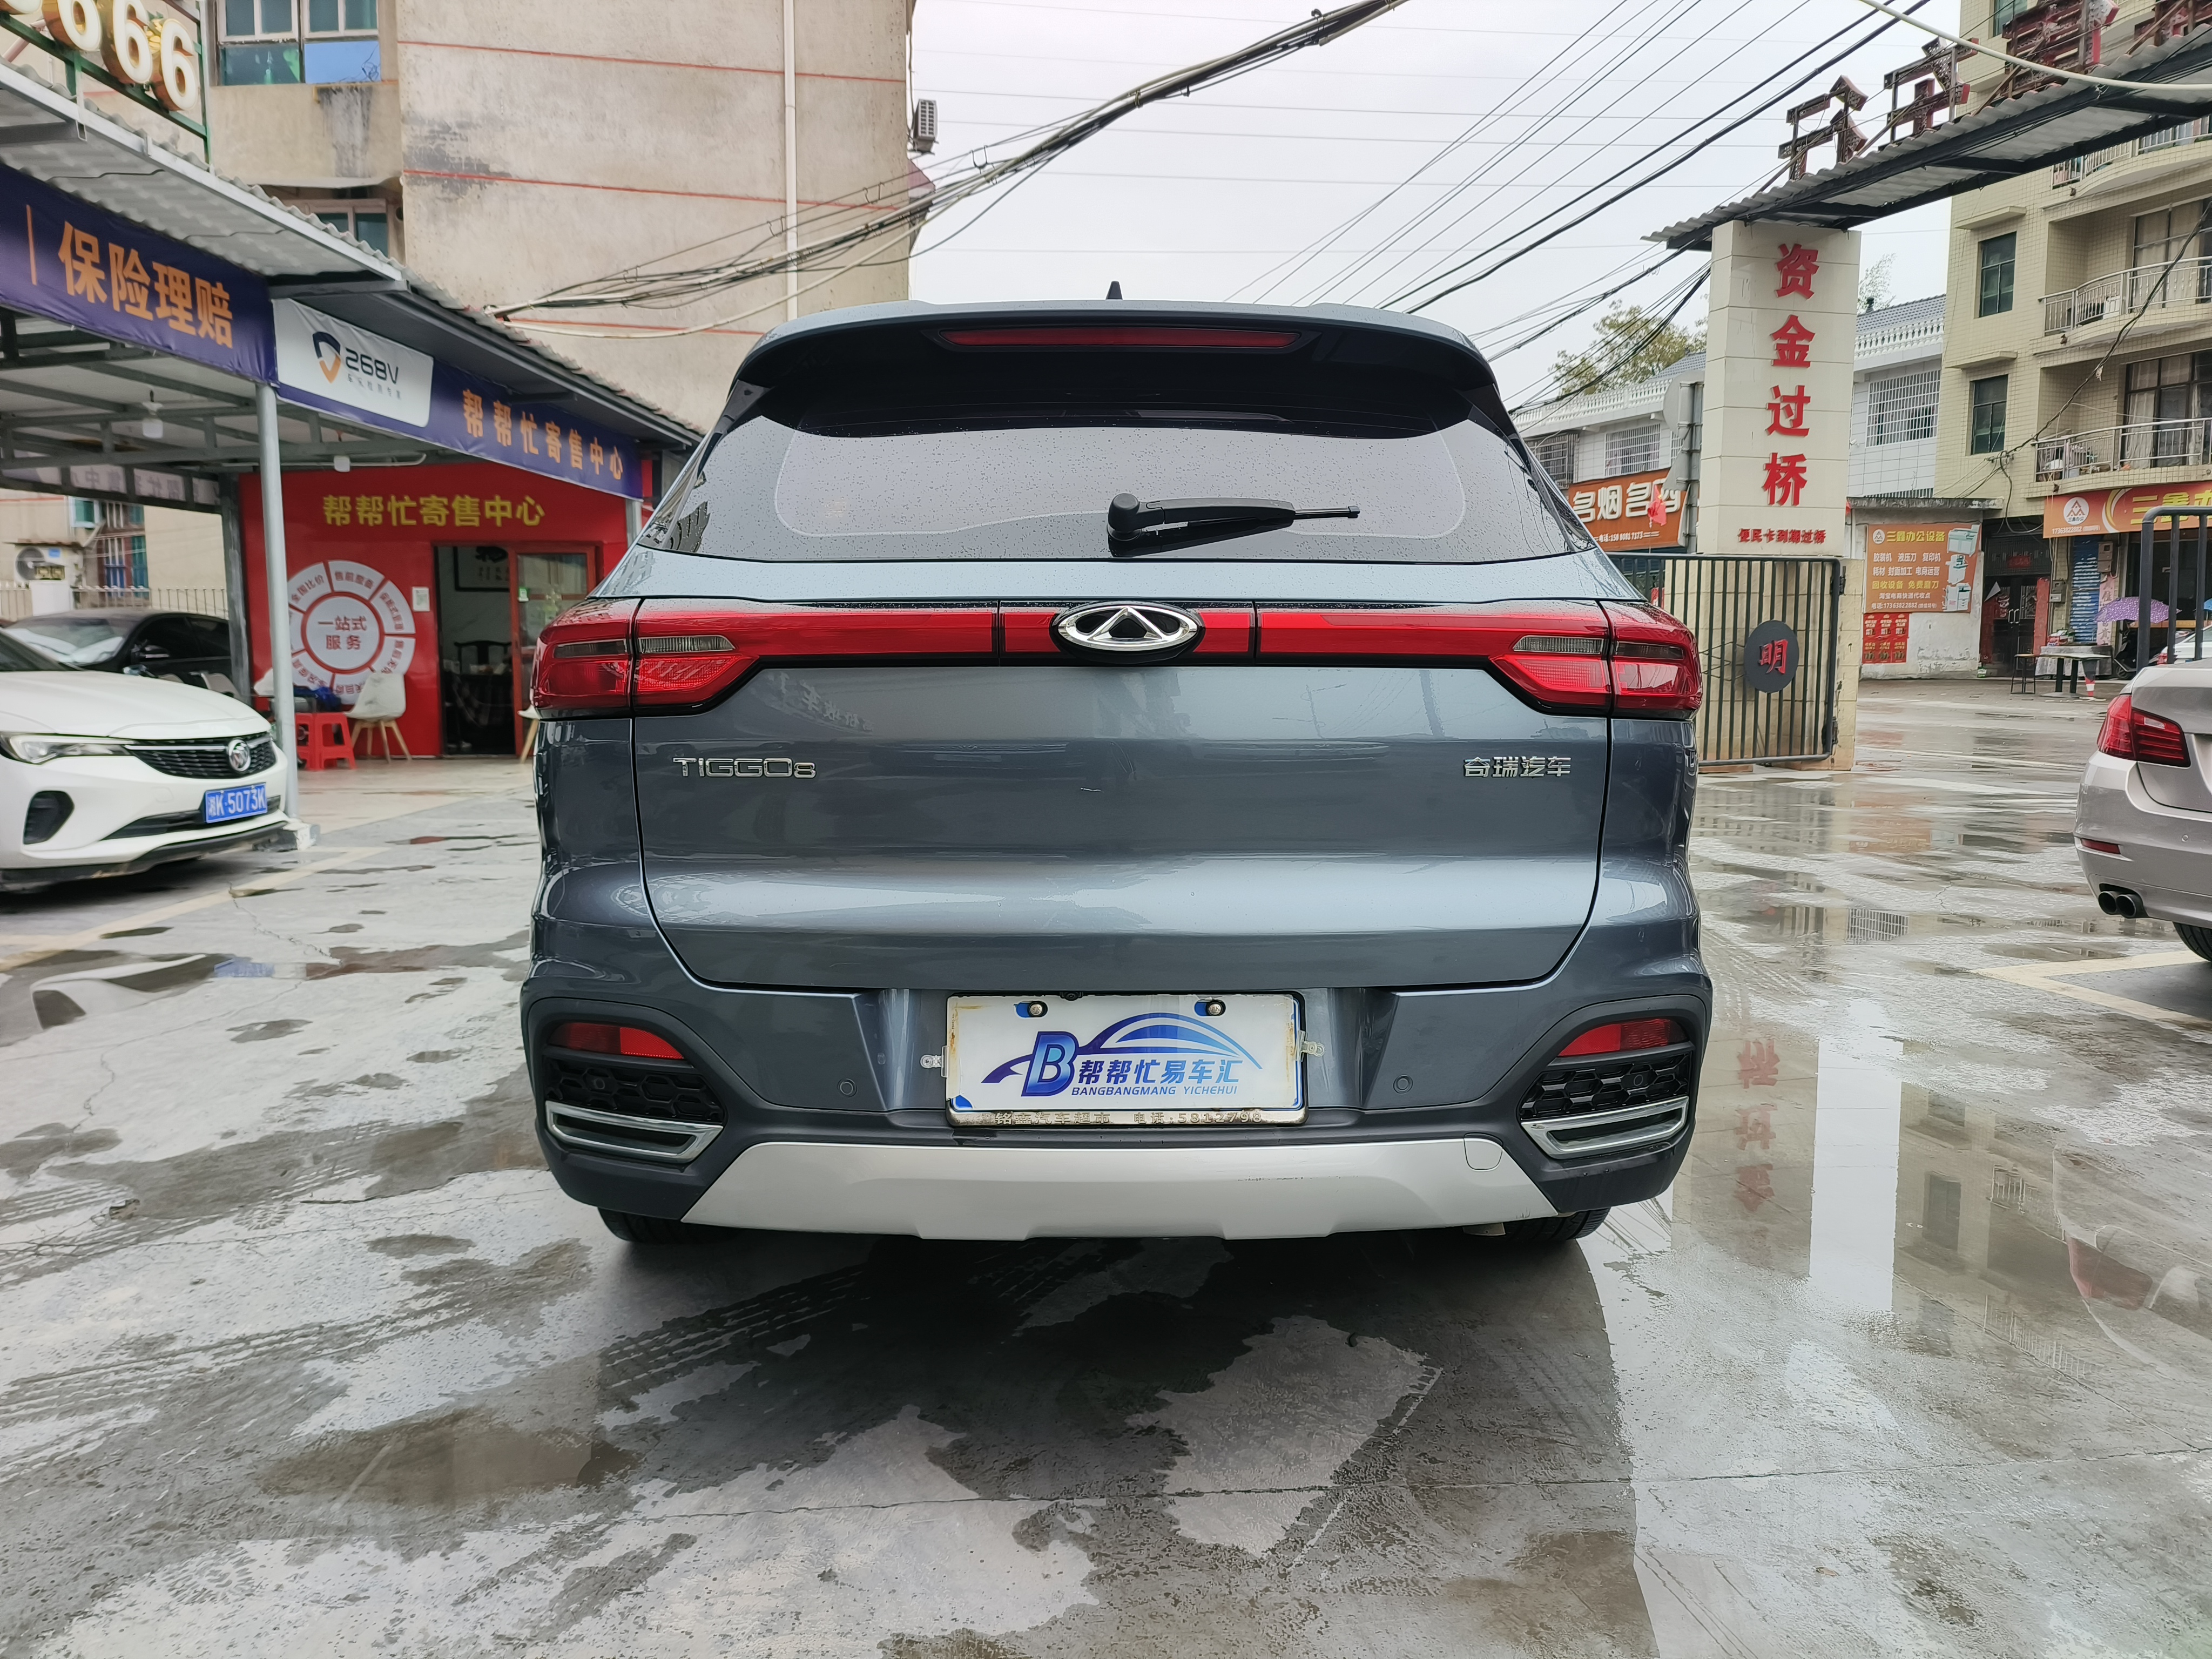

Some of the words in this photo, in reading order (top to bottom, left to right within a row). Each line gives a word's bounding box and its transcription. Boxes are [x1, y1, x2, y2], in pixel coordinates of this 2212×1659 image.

[58, 221, 233, 348] 保险理赔
[345, 347, 399, 385] 268V
[1762, 243, 1819, 506] 资金过桥
[463, 388, 623, 480] 帮帮忙寄售中心
[323, 494, 545, 527] 帮帮忙寄售中心
[1737, 528, 1826, 544] 便民卡到期过桥
[1886, 530, 1945, 543] 三鑫办公设备
[1873, 552, 1892, 562] 胶装机
[1897, 552, 1917, 562] 液压刀
[1922, 552, 1941, 562] 复印机
[1872, 567, 1885, 576] 耗材
[1887, 567, 1913, 576] 封面加工
[1916, 567, 1940, 576] 电商运营
[1872, 581, 1903, 589] 回收设备
[1908, 581, 1939, 589] 免费磨刀
[318, 615, 367, 631] 一站式
[326, 635, 361, 650] 服务
[1758, 639, 1788, 675] 明
[1464, 756, 1571, 777] 奇瑞汽车
[1078, 1059, 1243, 1085] 帮帮忙易车汇
[1071, 1086, 1176, 1096] BANGBANGMANG
[1183, 1086, 1237, 1095] YICHEHUI
[995, 1112, 1110, 1125] 铭鑫汽车超市
